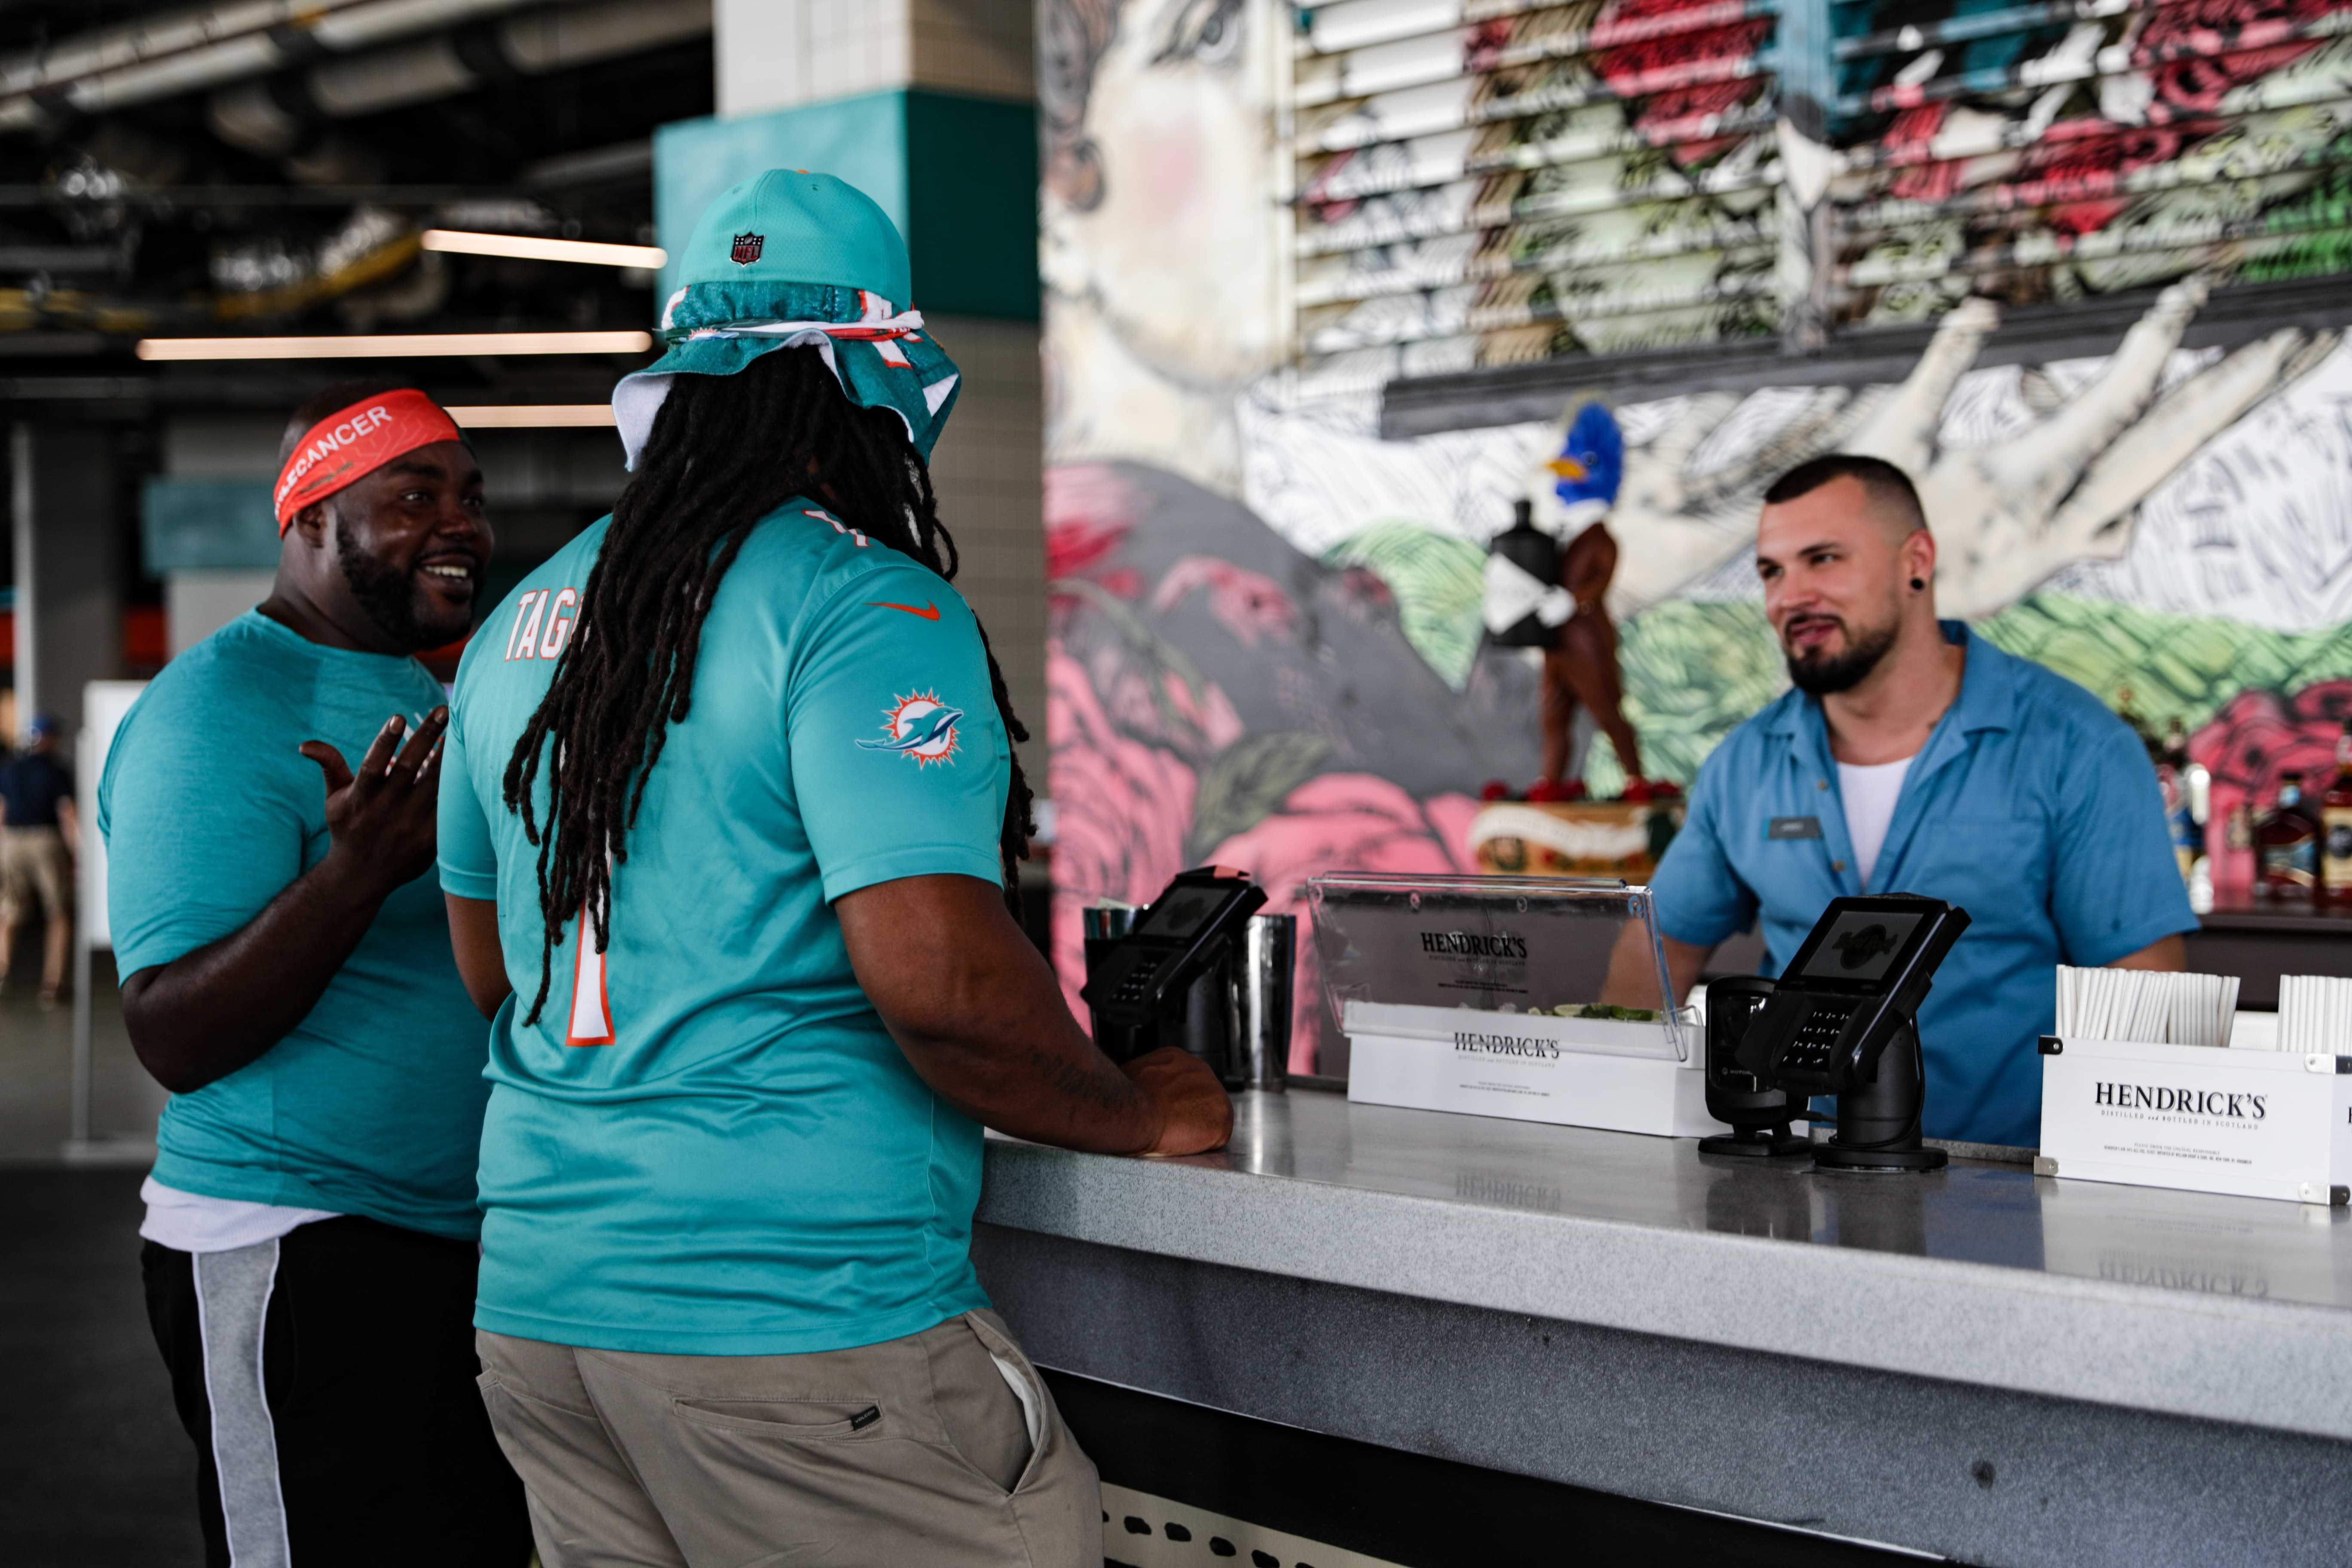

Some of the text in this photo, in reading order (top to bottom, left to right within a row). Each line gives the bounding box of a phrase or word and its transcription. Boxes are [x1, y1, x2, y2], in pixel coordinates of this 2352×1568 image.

[733, 246, 760, 262] NFL
[505, 587, 590, 662] TAG
[1421, 932, 1528, 959] HENDRICK'S
[1455, 1032, 1559, 1059] HENDRICK'S
[2095, 1082, 2266, 1120] HENDRICK'S
[2101, 1110, 2144, 1119] DISTILLED
[2216, 1121, 2259, 1130] SCOTLAND
[854, 1409, 875, 1423] VOLCOM
